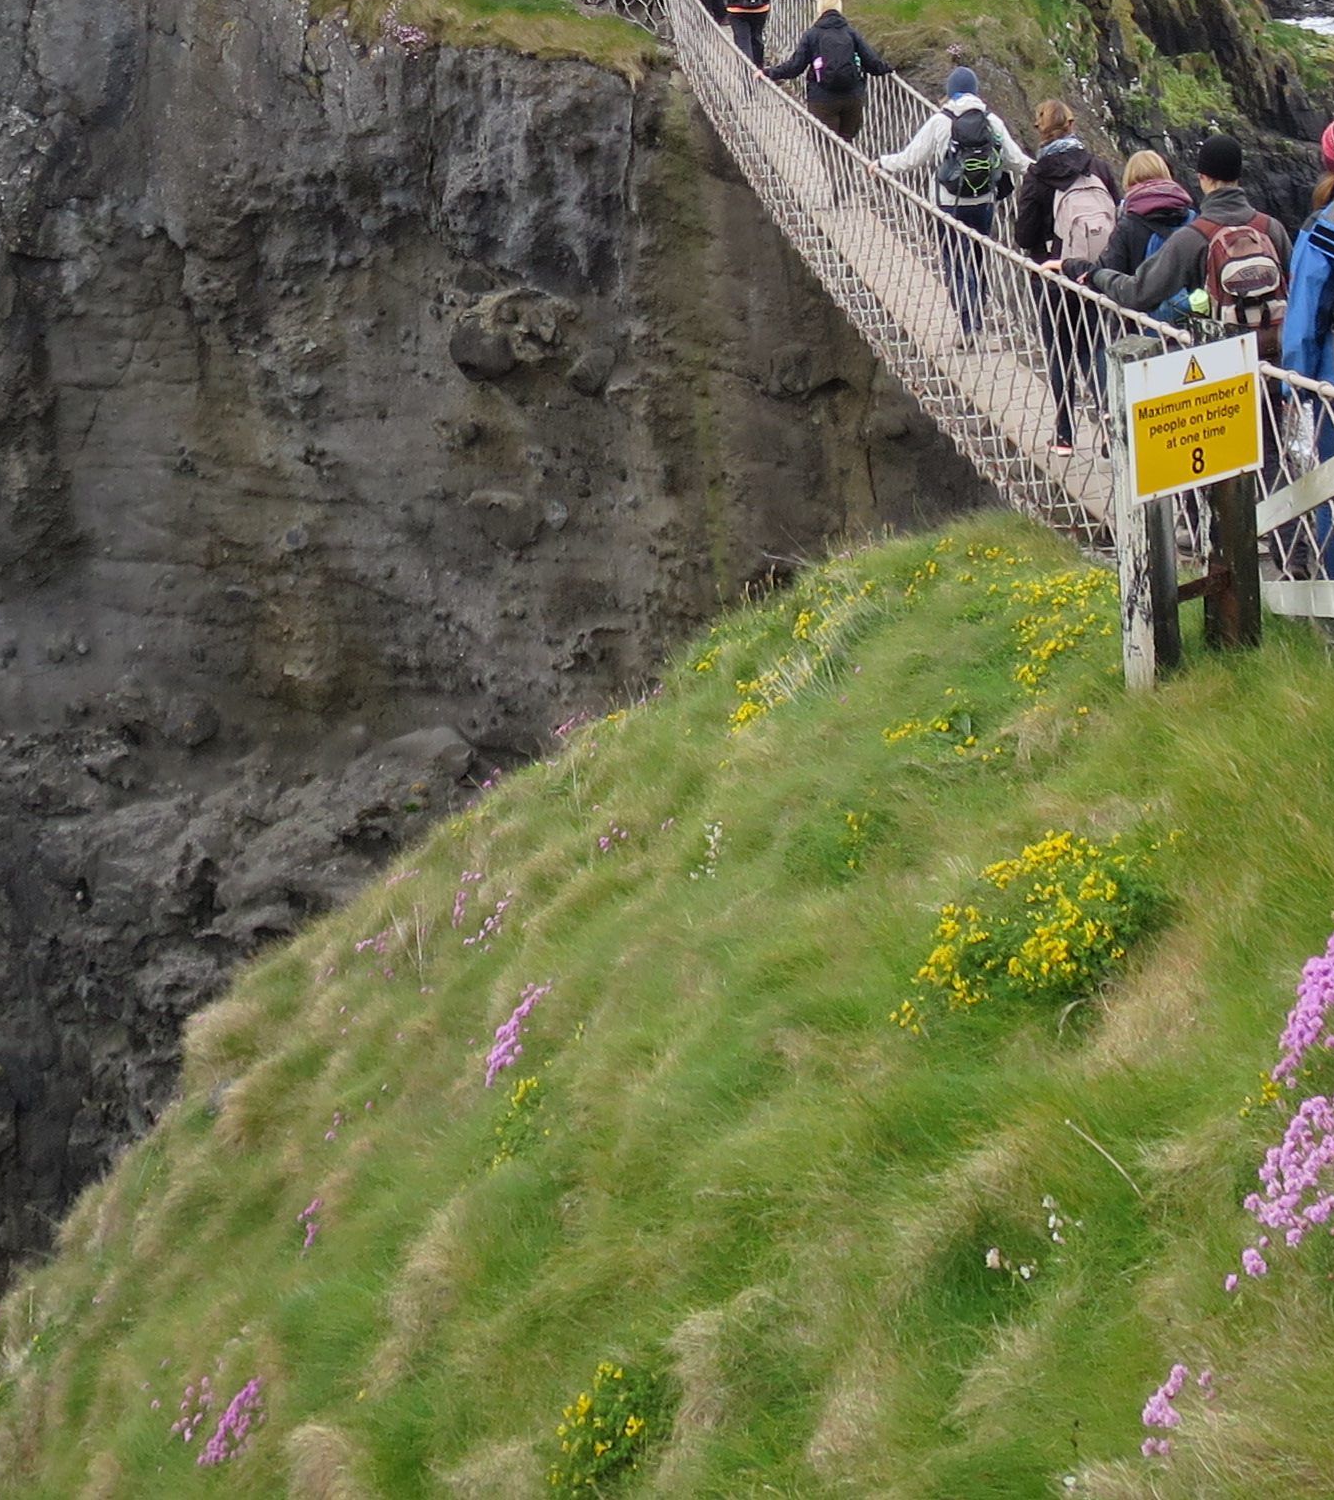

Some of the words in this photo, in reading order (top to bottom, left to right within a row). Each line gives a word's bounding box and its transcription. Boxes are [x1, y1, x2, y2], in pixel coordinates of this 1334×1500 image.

[1138, 399, 1192, 420] Maximum
[1195, 387, 1236, 406] number
[1238, 381, 1249, 395] of
[1149, 417, 1187, 438] people
[1190, 414, 1204, 425] on
[1207, 404, 1240, 419] bridge
[1166, 437, 1178, 449] at
[1180, 432, 1200, 446] one
[1203, 426, 1226, 439] time
[1192, 447, 1205, 474] 8
